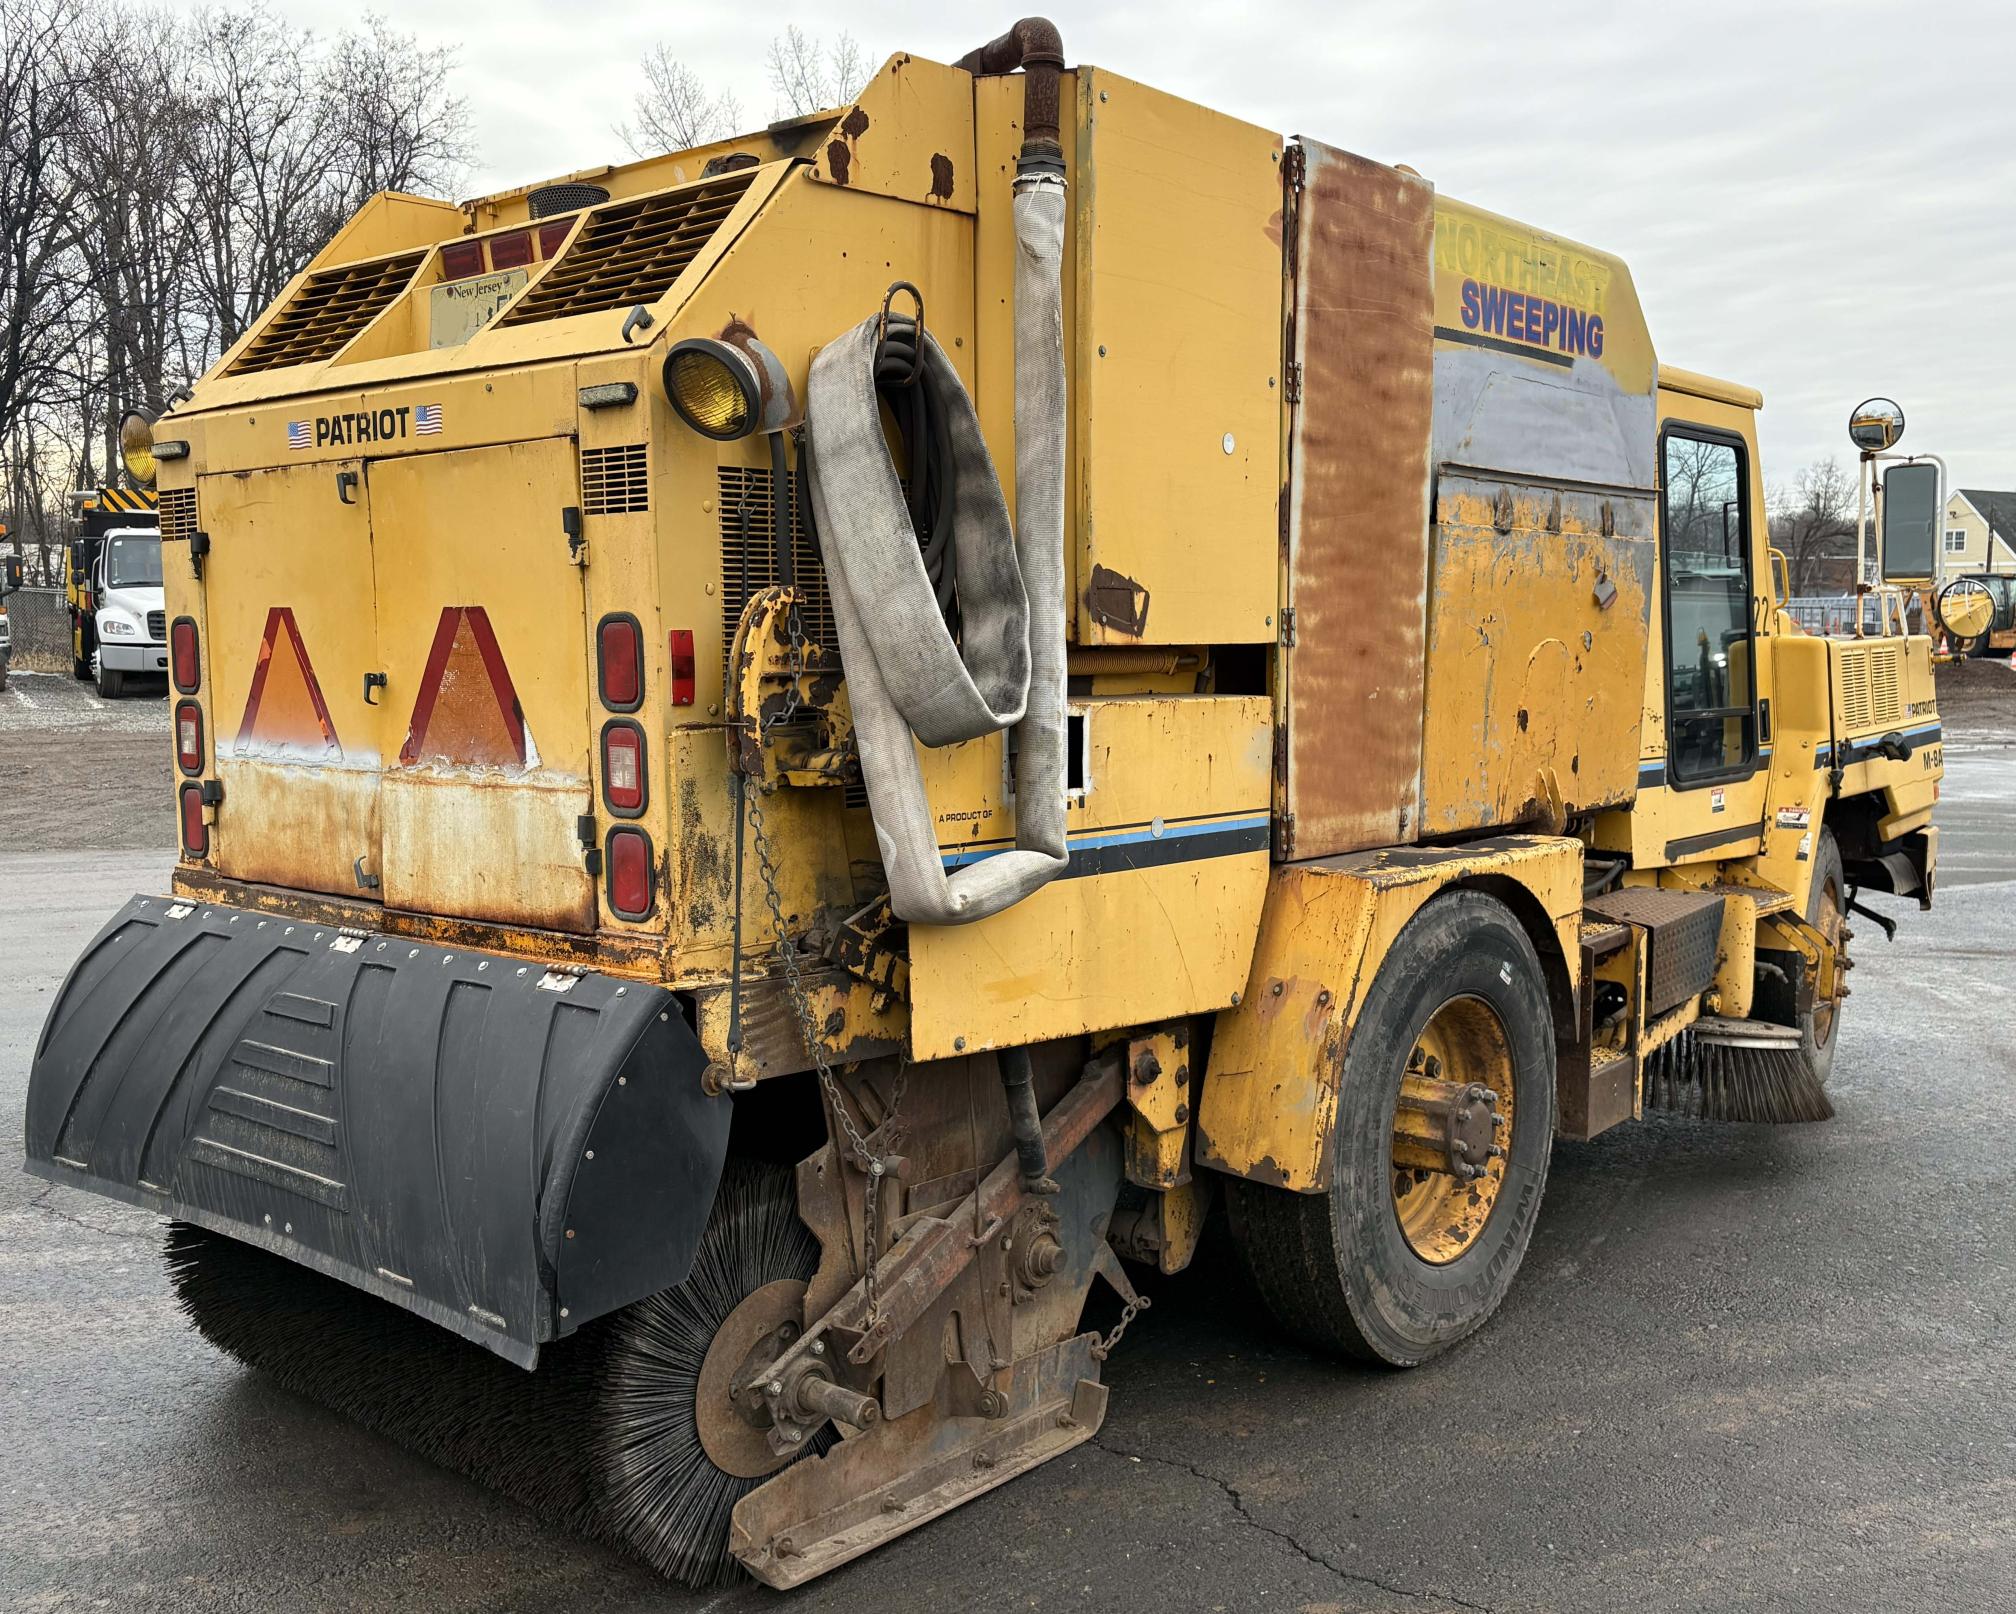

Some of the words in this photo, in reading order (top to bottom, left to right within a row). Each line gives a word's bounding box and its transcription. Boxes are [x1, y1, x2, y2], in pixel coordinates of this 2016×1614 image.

[1435, 217, 1609, 314] NORTHEAST
[454, 286, 474, 299] New
[475, 282, 502, 298] Jersey
[1461, 278, 1604, 360] SWEEPING
[316, 406, 410, 447] PATRIOT
[1912, 699, 1936, 717] PATRIOT
[939, 814, 945, 823] A
[946, 811, 982, 822] PRODUCT
[983, 810, 993, 819] OF
[1398, 1184, 1534, 1314] WINDPOWER
